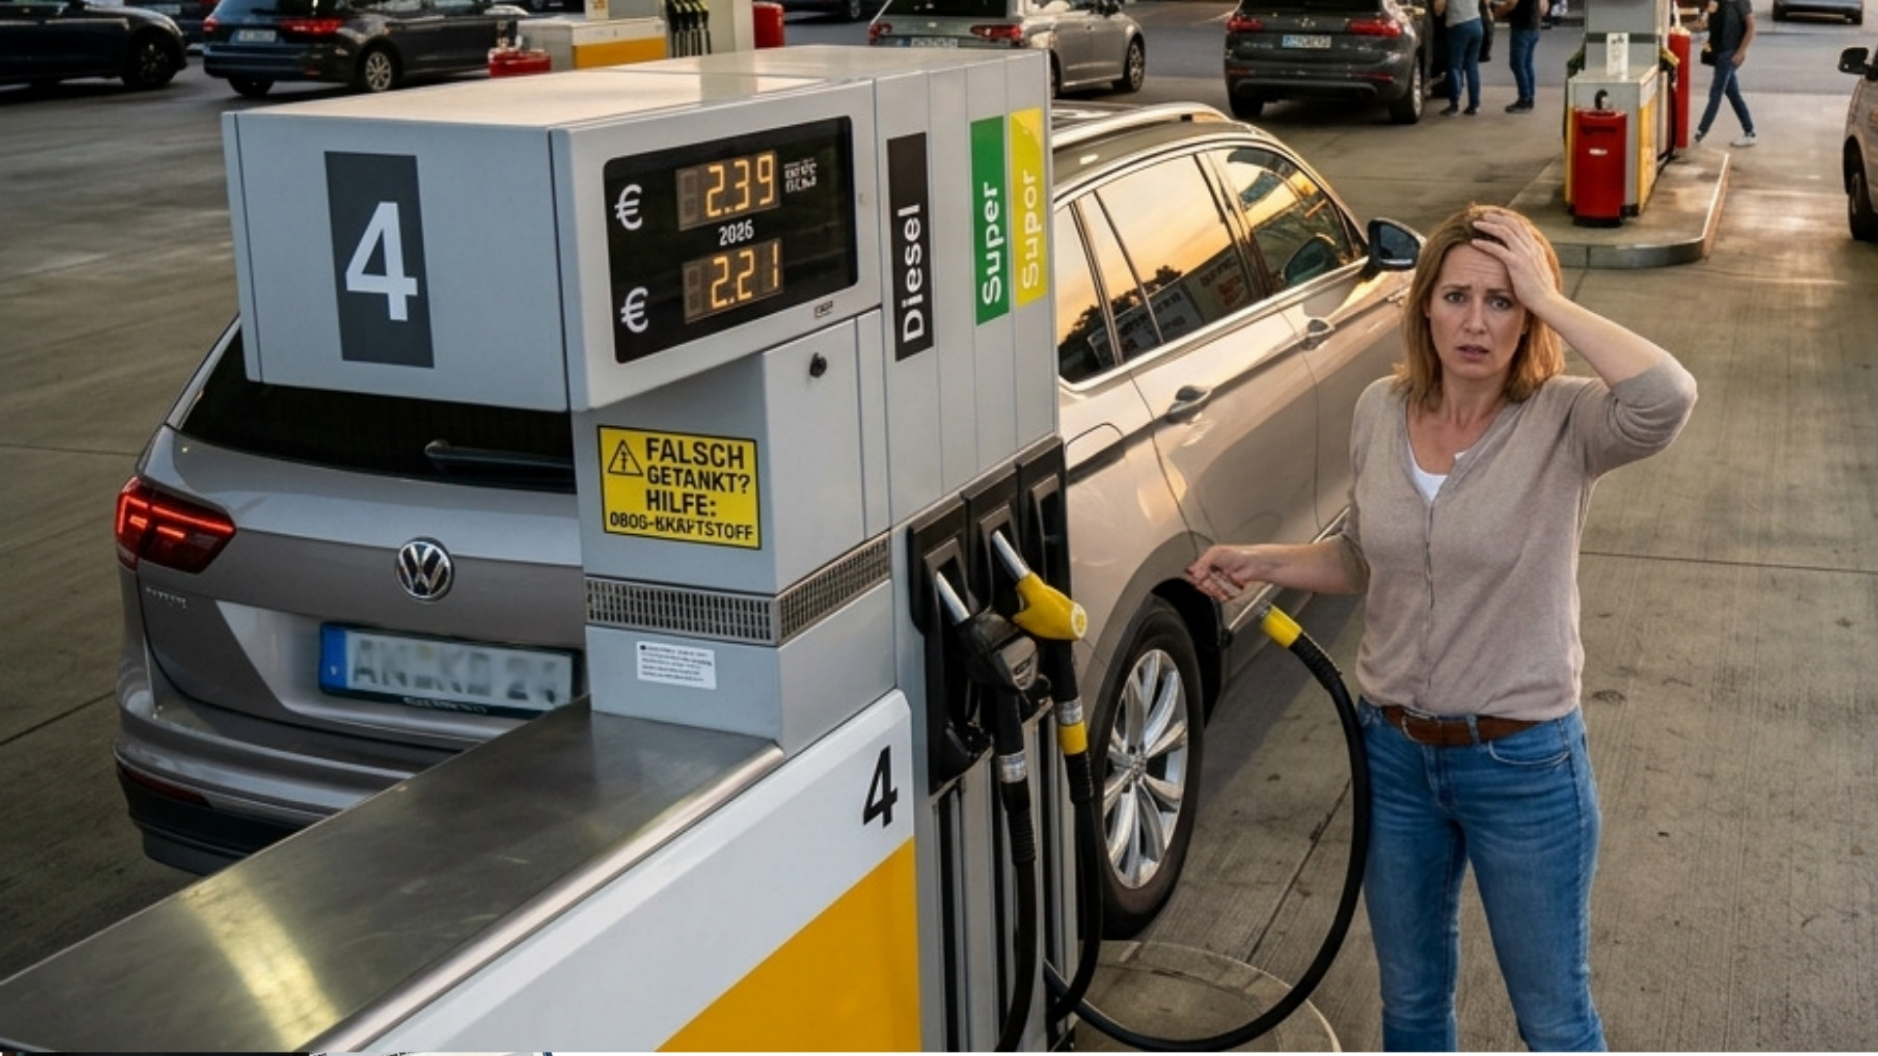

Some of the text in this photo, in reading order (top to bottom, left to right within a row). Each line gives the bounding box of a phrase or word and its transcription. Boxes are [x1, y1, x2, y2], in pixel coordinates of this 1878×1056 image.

[706, 154, 774, 218] 2.39
[345, 201, 418, 322] 4
[982, 181, 1005, 306] Super
[1022, 168, 1042, 290] Supor
[710, 241, 780, 310] 2.21
[897, 203, 925, 343] Diesel
[646, 437, 745, 470] FALSCH
[647, 465, 751, 495] GETANKT?
[646, 489, 717, 517] HILFE:
[862, 745, 898, 829] 4
